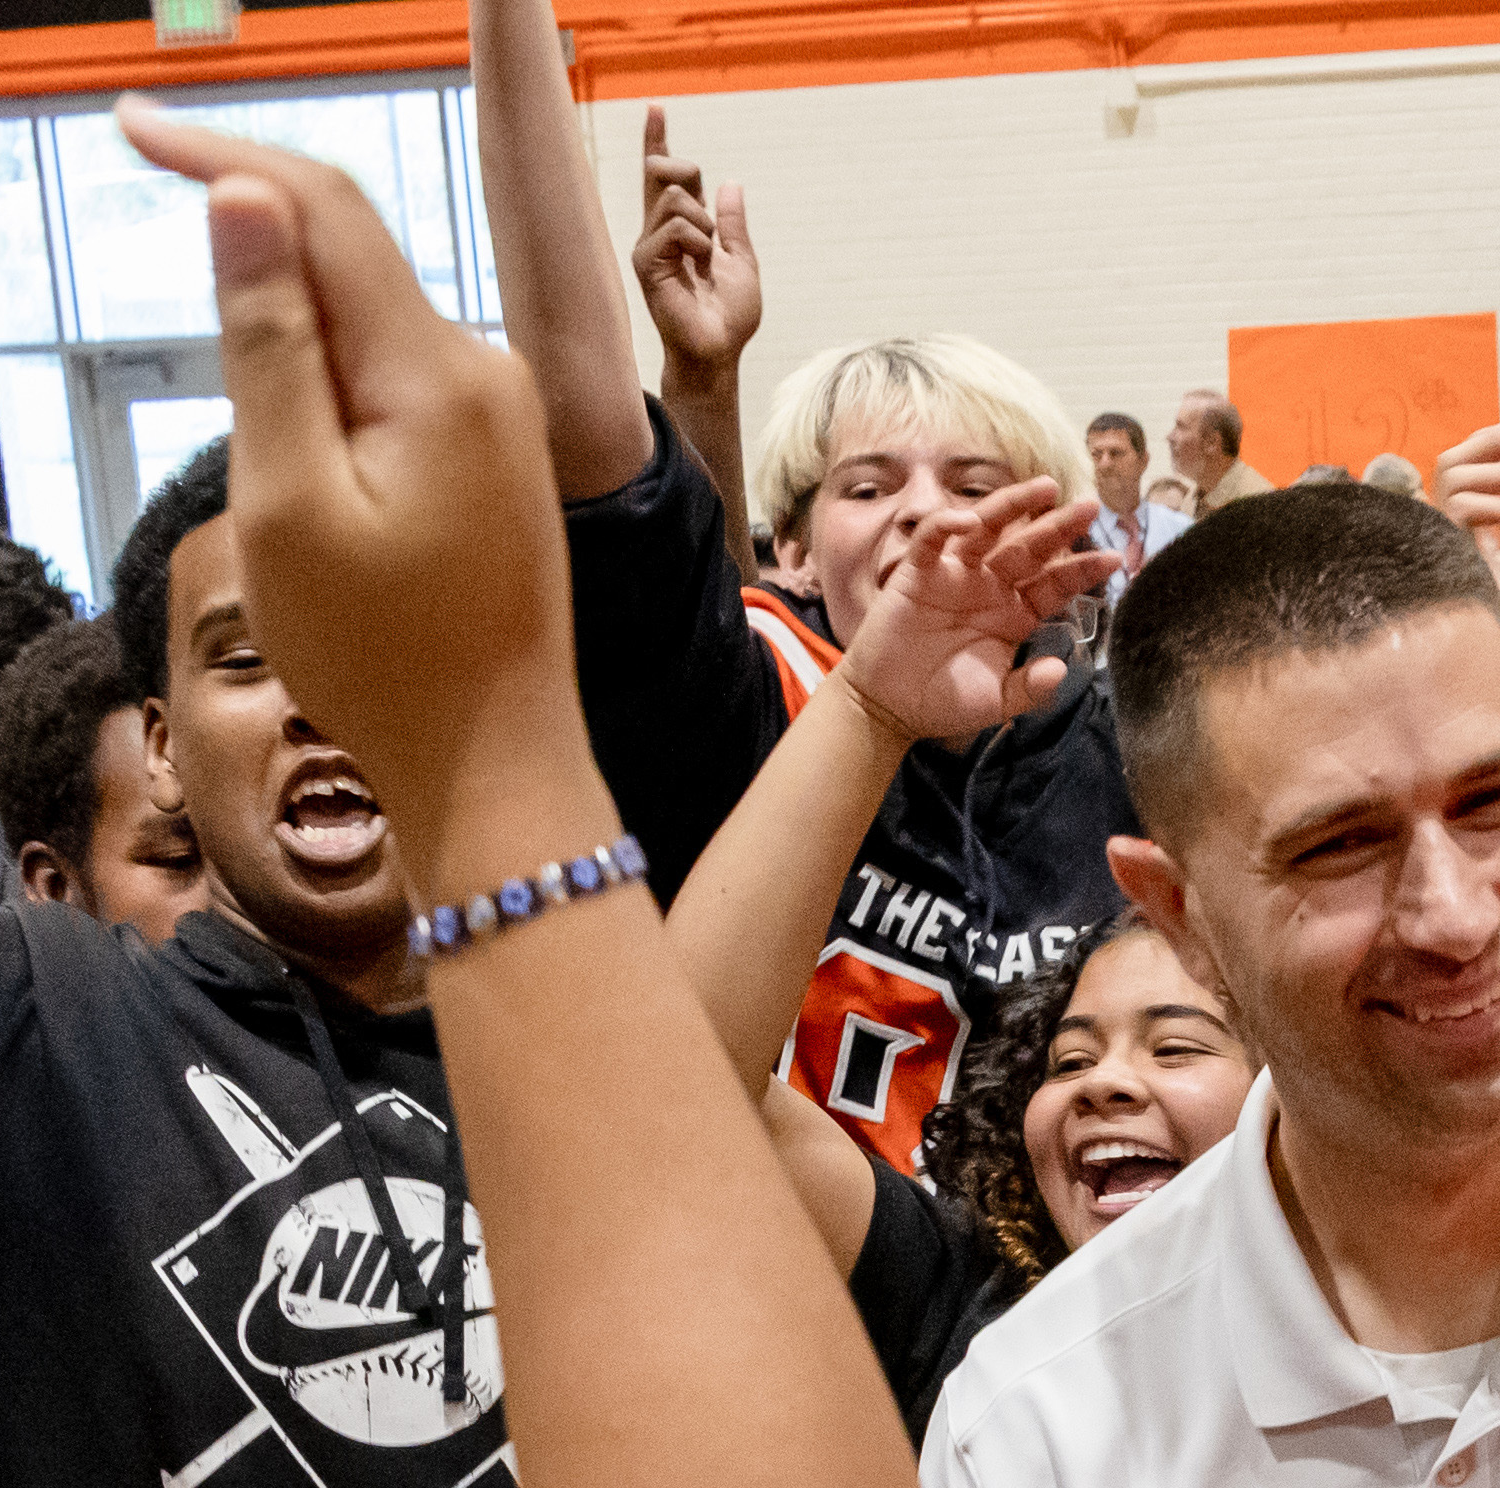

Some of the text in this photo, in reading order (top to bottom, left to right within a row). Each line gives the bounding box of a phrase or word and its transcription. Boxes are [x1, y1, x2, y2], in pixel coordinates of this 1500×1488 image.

[847, 862, 1093, 984] THE AS
[288, 1225, 480, 1314] NIK
